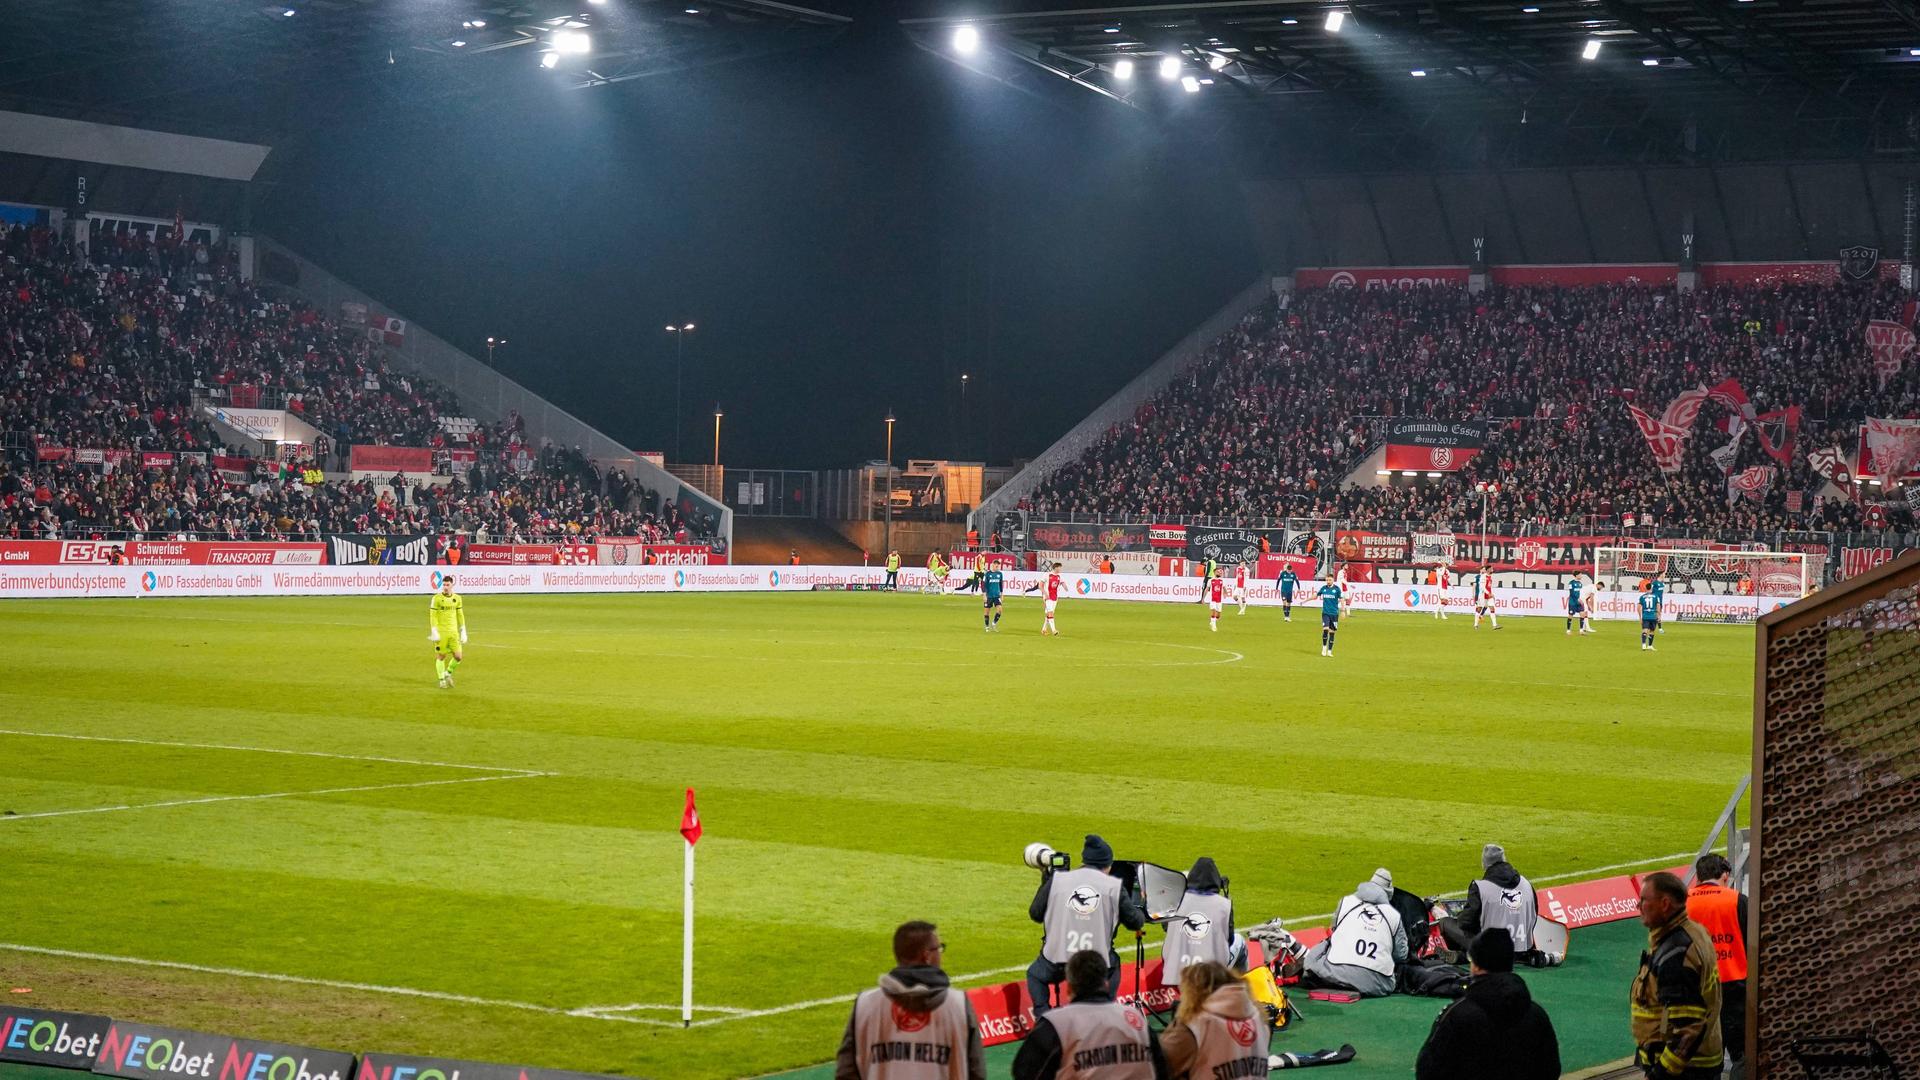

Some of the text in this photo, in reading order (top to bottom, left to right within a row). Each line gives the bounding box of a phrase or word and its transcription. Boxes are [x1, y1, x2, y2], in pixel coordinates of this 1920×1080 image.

[78, 177, 86, 190] R
[78, 192, 86, 204] 5
[1473, 237, 1484, 248] W
[1682, 234, 1694, 245] W
[246, 415, 279, 428] GROUP
[1393, 423, 1480, 438] Commando Essen
[1414, 435, 1458, 445] Since 2012
[1149, 531, 1187, 540] West Boys
[1194, 531, 1235, 546] Essener
[137, 543, 187, 555] Schwerlast-
[331, 535, 429, 566] WILD BOYS
[4, 551, 30, 561] GmbH
[211, 552, 272, 564] TRANSPORTE
[485, 551, 512, 561] GRUPPE
[529, 553, 552, 562] GRUPPE
[1219, 552, 1242, 563] 1980
[157, 574, 262, 589] MD Fassadenbau GmbH
[273, 571, 420, 591] Wärmedämmverbundsysteme
[459, 573, 507, 587] Fassadenbau
[508, 574, 531, 587] GmbH
[543, 571, 666, 589] Wärmedämmverbundsysteme
[685, 572, 759, 585] MD Fassadenbau GmbH
[780, 573, 791, 584] MD
[792, 572, 847, 585] Fassadenbau
[1091, 582, 1200, 597] MD Fassadenbau GmbH
[1421, 593, 1438, 605] MD
[1511, 597, 1543, 610] GmbH
[1644, 597, 1654, 609] 11
[1567, 897, 1638, 925] Sparkasse Essen
[1067, 930, 1094, 952] 26
[1355, 938, 1378, 960] 02
